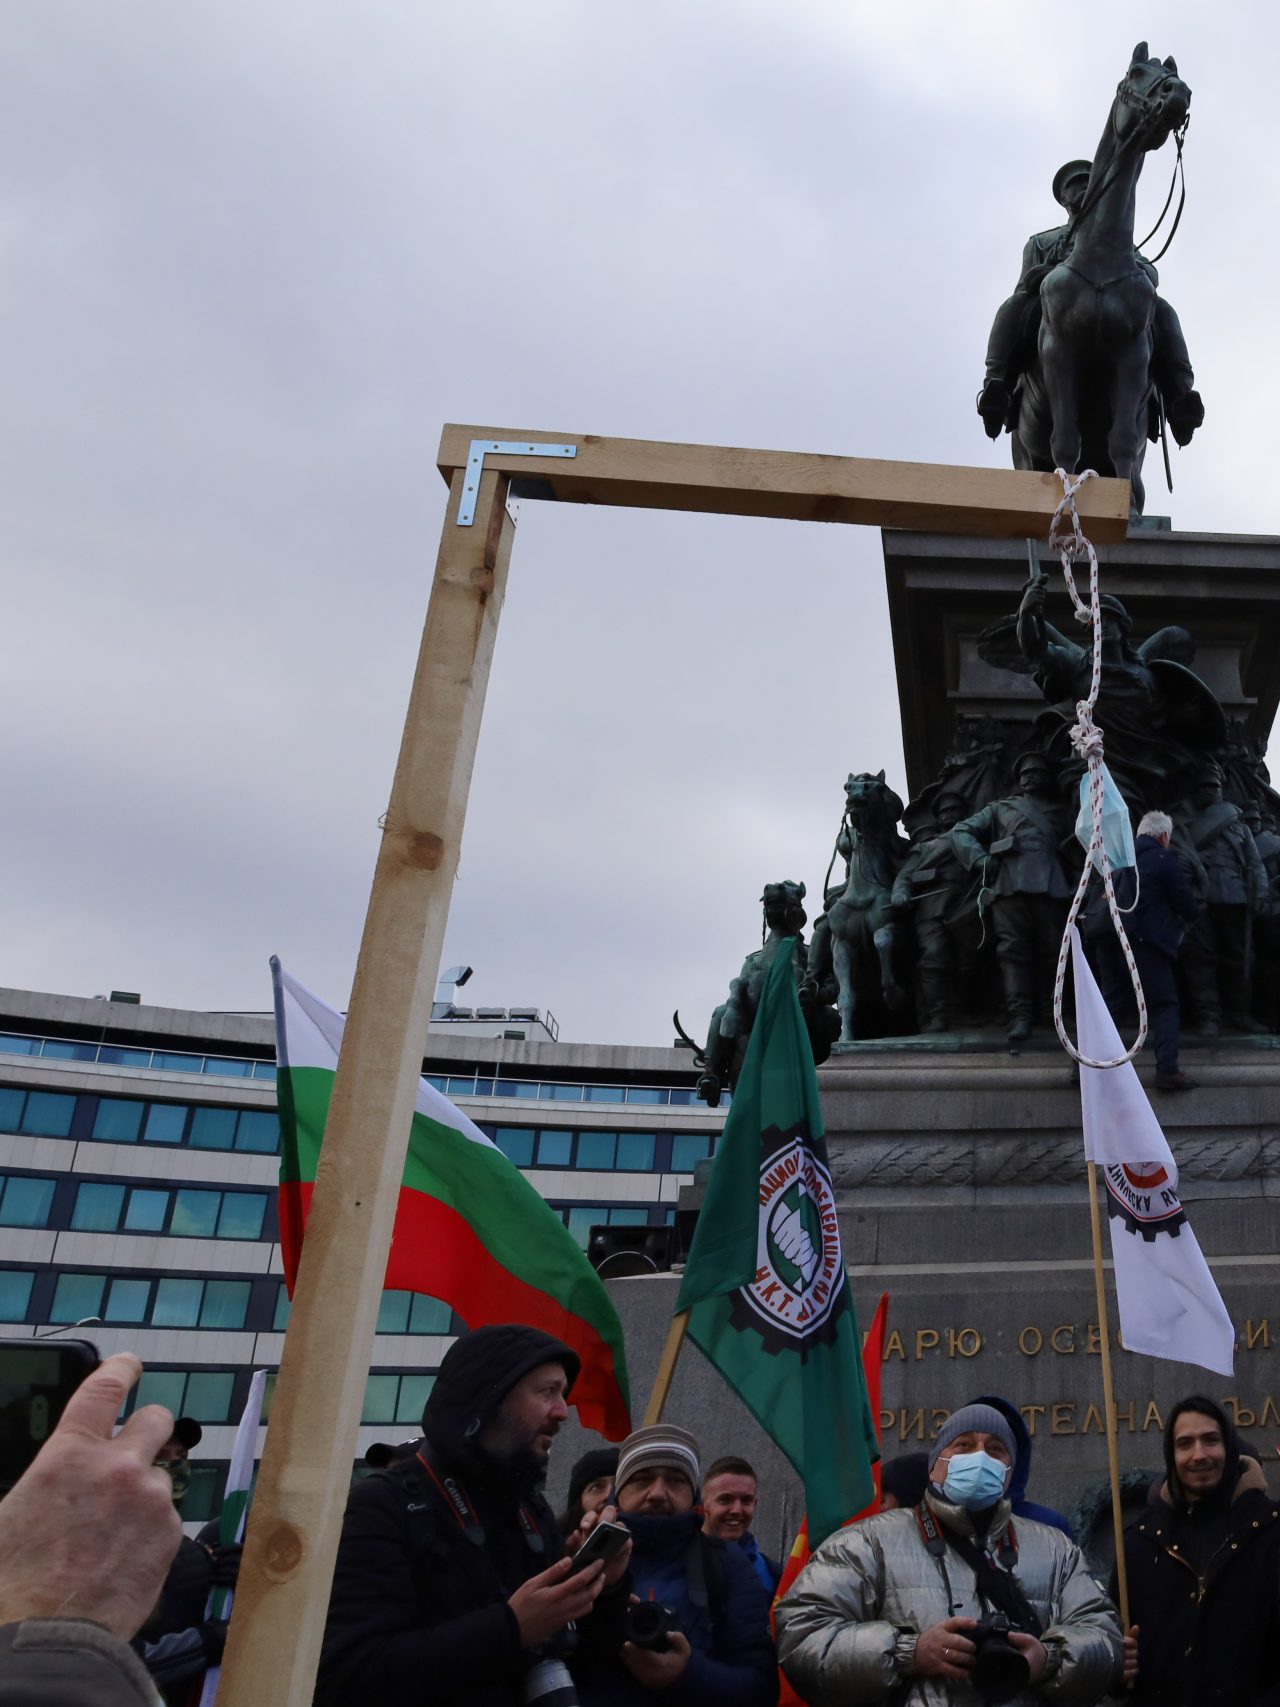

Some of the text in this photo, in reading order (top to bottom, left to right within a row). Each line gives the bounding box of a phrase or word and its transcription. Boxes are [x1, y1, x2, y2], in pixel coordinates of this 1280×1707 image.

[759, 1151, 800, 1208] НАЦИОН
[801, 1161, 839, 1281] ОНФЕДЕРАЦИЯ
[863, 1326, 982, 1360] АРЮ
[444, 1477, 469, 1515] Canon
